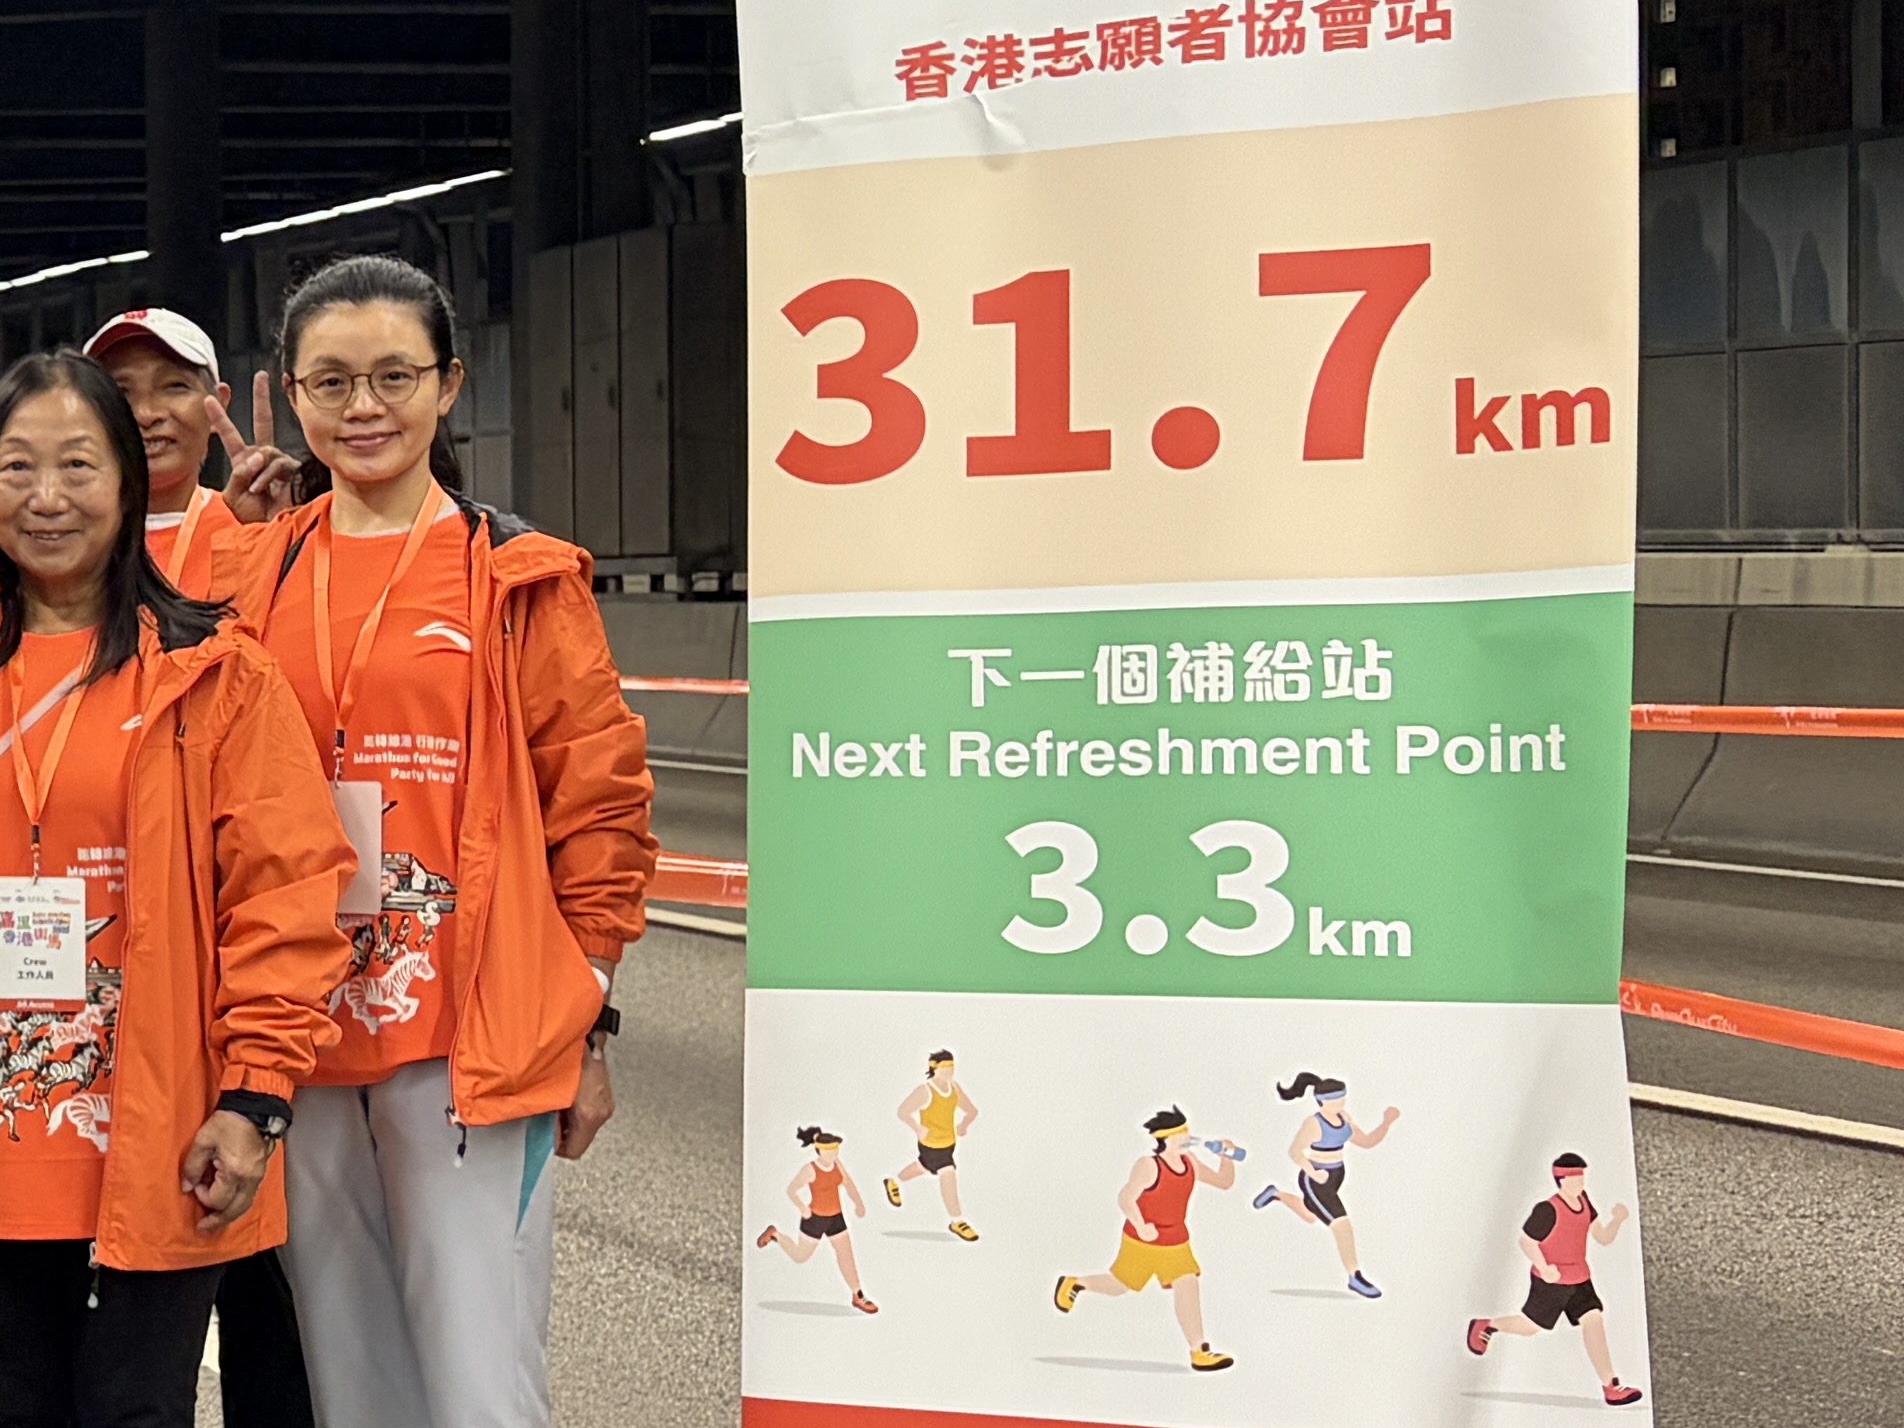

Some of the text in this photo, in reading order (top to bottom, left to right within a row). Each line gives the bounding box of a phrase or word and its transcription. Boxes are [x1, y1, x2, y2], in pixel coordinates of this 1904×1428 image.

[775, 243, 1611, 485] 31.7 km
[947, 639, 1394, 708] 下一個補給站
[790, 722, 1567, 778] Next Refreshment Point
[1001, 821, 1413, 959] 3.3 km
